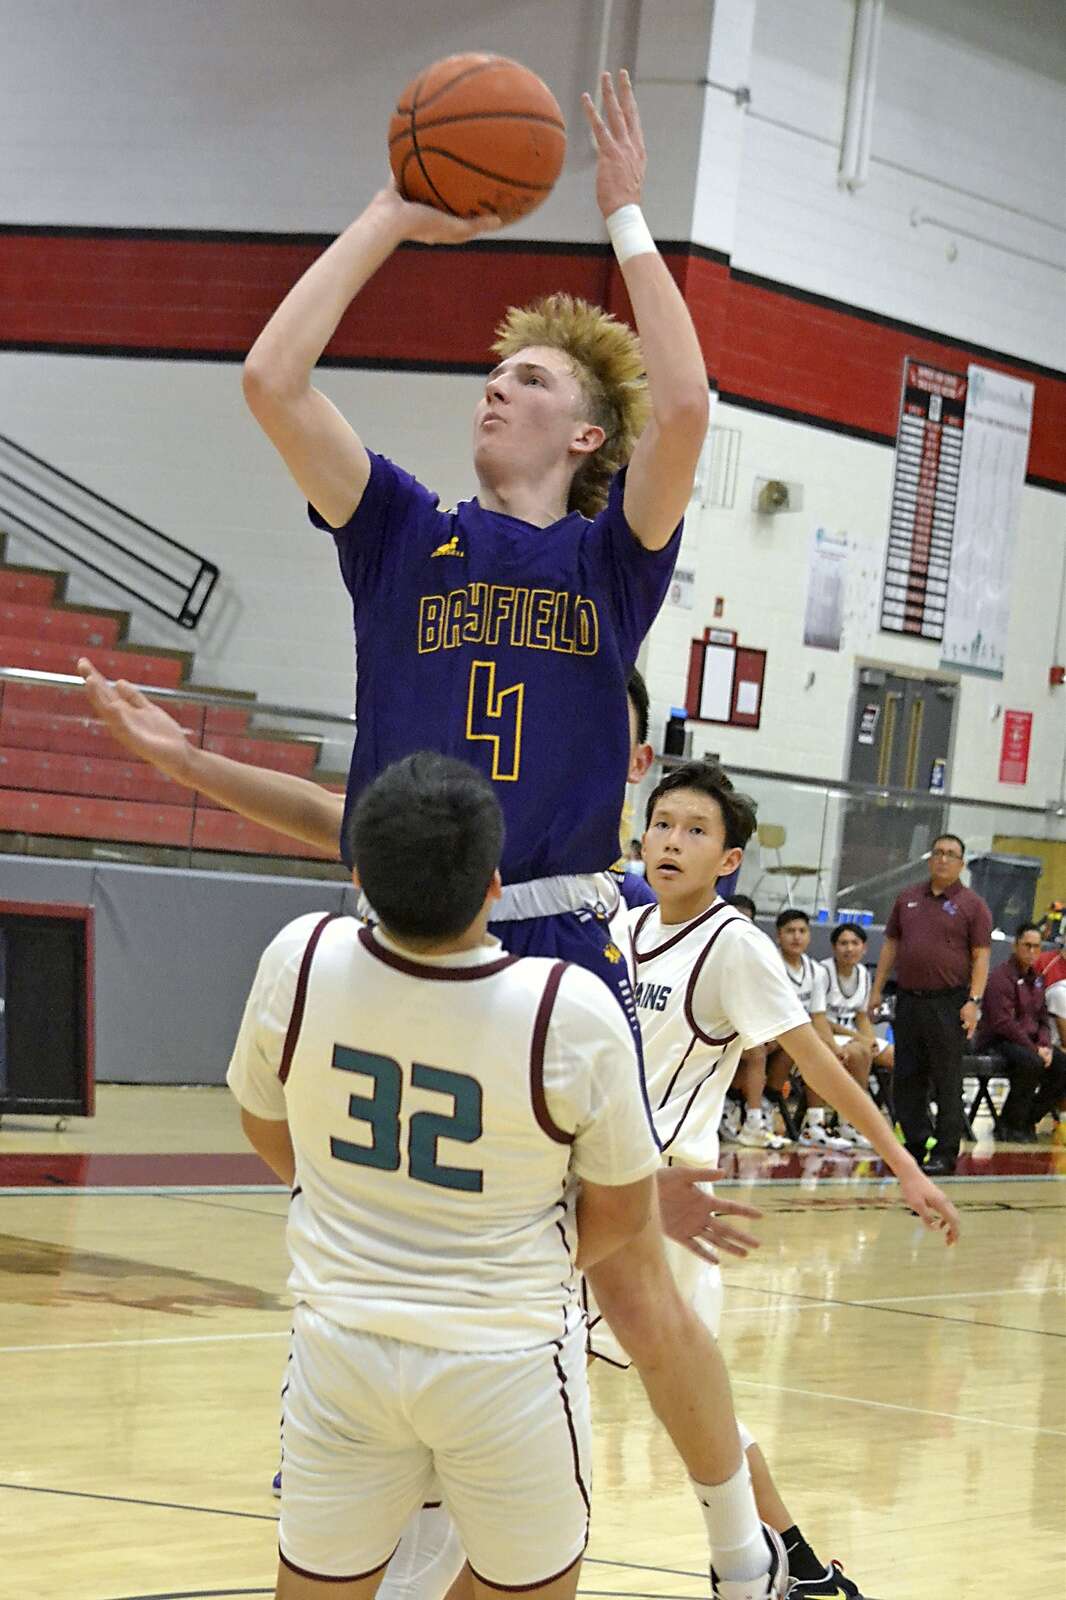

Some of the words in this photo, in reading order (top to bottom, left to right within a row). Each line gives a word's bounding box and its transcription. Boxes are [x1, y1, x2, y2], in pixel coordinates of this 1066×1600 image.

[418, 582, 599, 656] BAYFIELD
[466, 660, 525, 782] 4
[329, 1043, 483, 1193] 32
